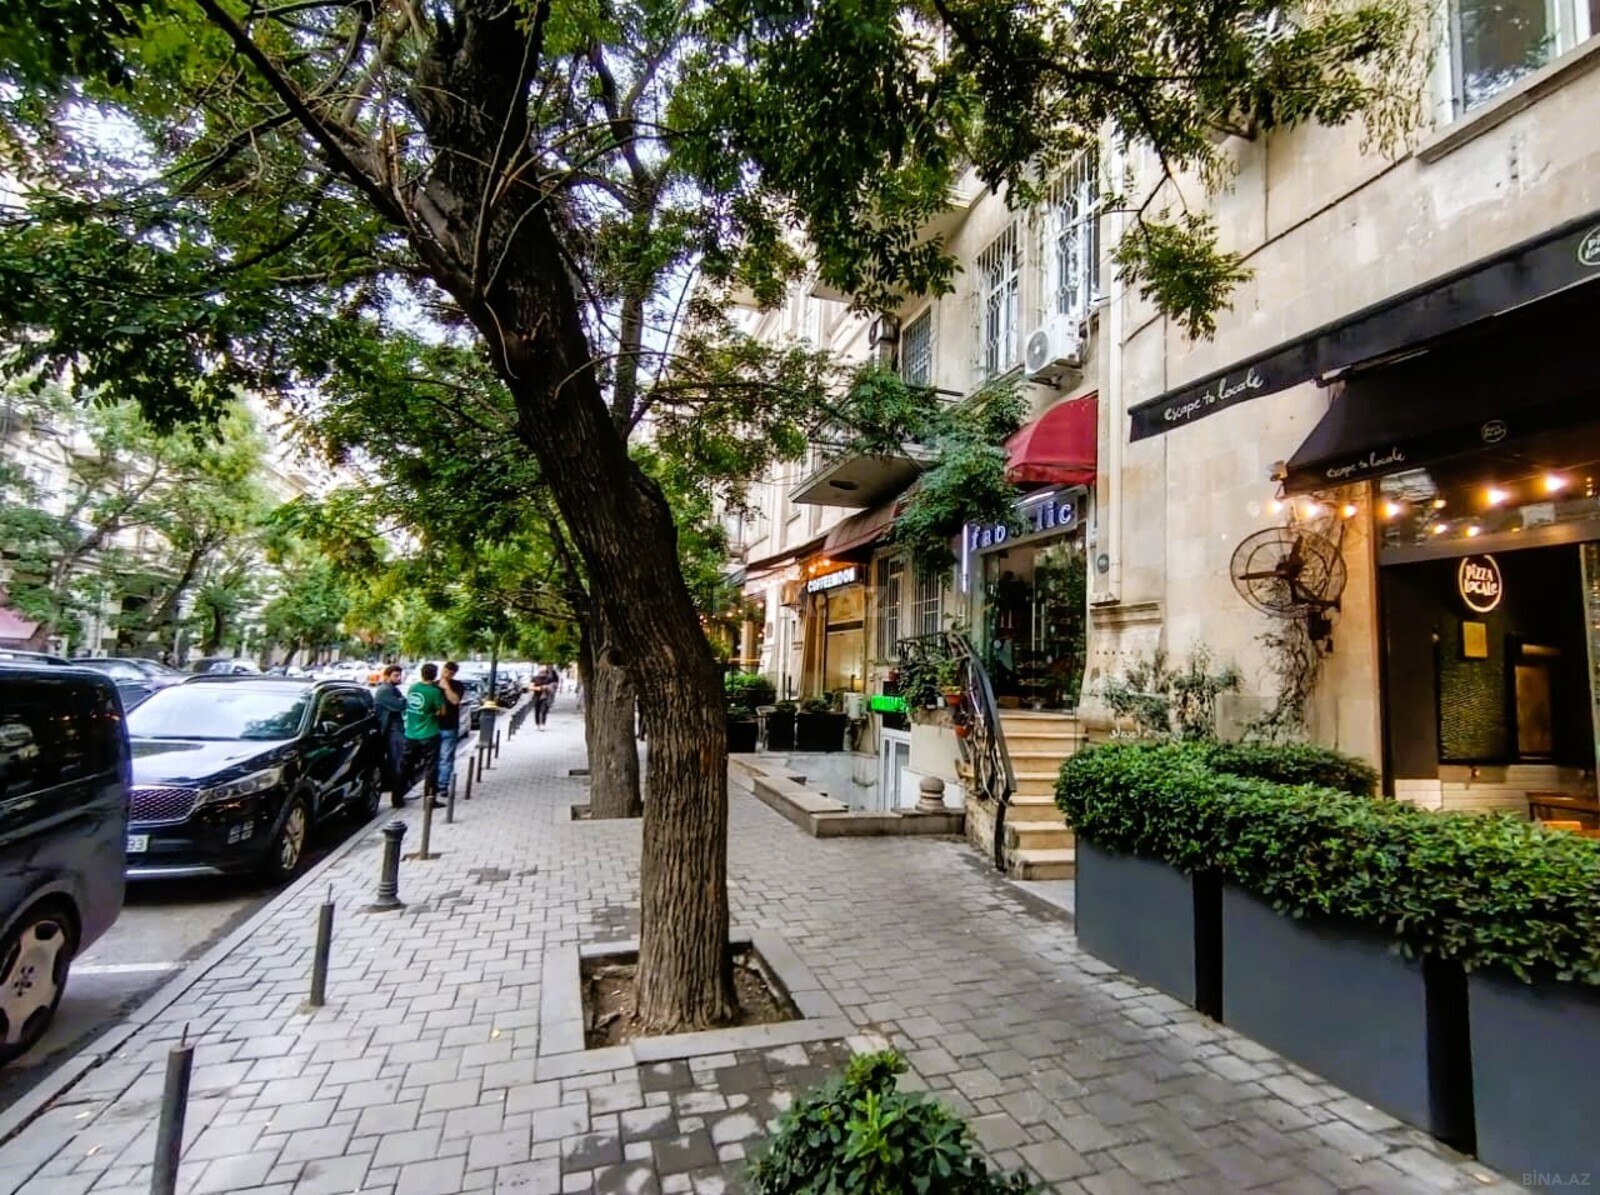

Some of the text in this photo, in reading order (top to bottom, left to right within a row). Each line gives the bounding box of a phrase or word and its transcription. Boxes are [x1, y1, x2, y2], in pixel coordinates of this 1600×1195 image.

[1164, 367, 1264, 421] escape to locale
[969, 500, 1071, 553] fablic
